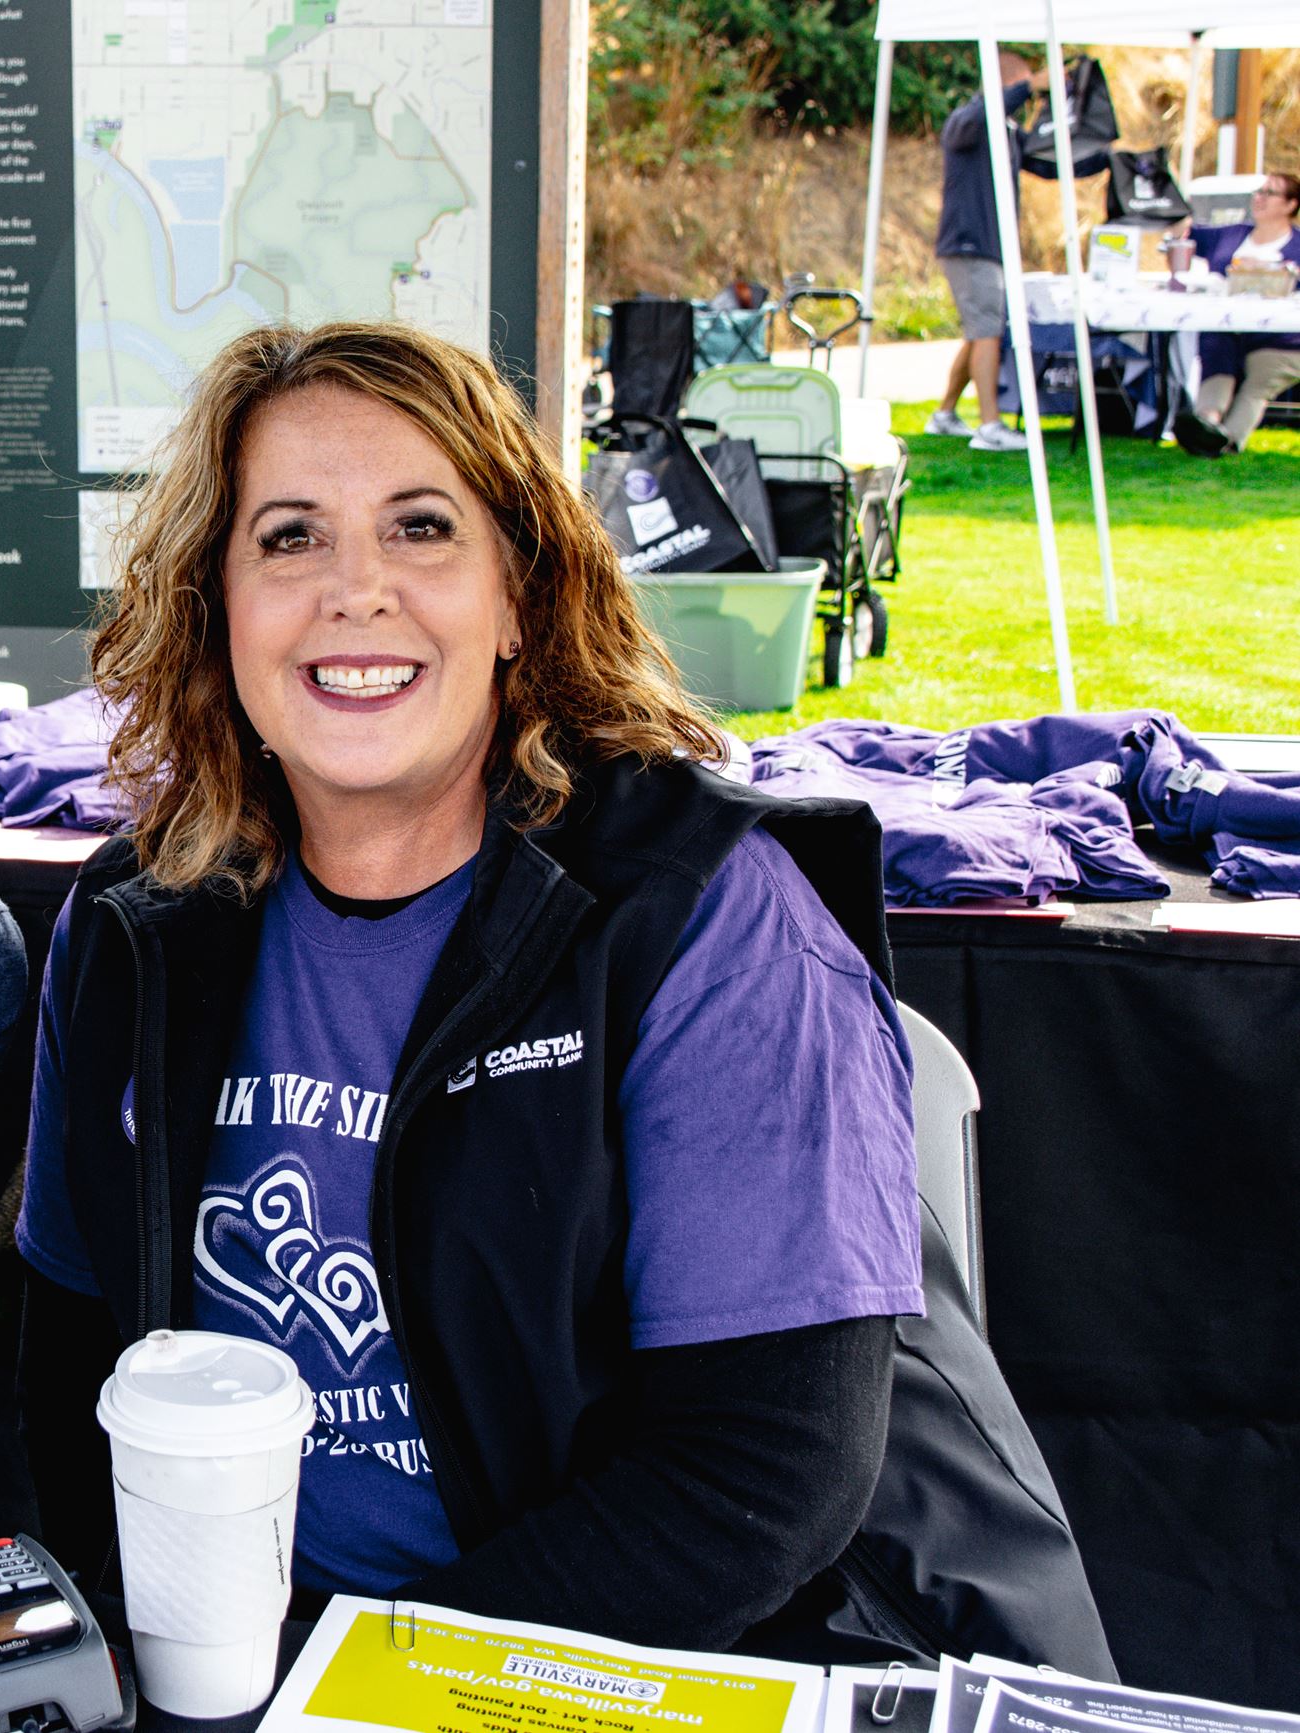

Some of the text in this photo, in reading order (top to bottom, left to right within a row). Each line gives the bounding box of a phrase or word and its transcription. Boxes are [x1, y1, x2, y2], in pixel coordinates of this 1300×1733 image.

[484, 1030, 583, 1068] COASTAL
[489, 1050, 582, 1078] COMMUNITY BANK
[270, 1073, 332, 1128] THE
[533, 1646, 556, 1657] WA
[510, 1655, 558, 1669] RECREATION
[505, 1661, 626, 1695] MARYSVILLE
[565, 1667, 601, 1679] CULTURE
[601, 1674, 629, 1684] PARKS,
[637, 1667, 673, 1680] Road
[406, 1660, 703, 1725] marysvillewa.gov/parks
[448, 1688, 635, 1732] Rock Art Dot Painting
[456, 1703, 522, 1724] Painting
[1106, 1703, 1144, 1715] support
[1120, 1712, 1173, 1728] happening
